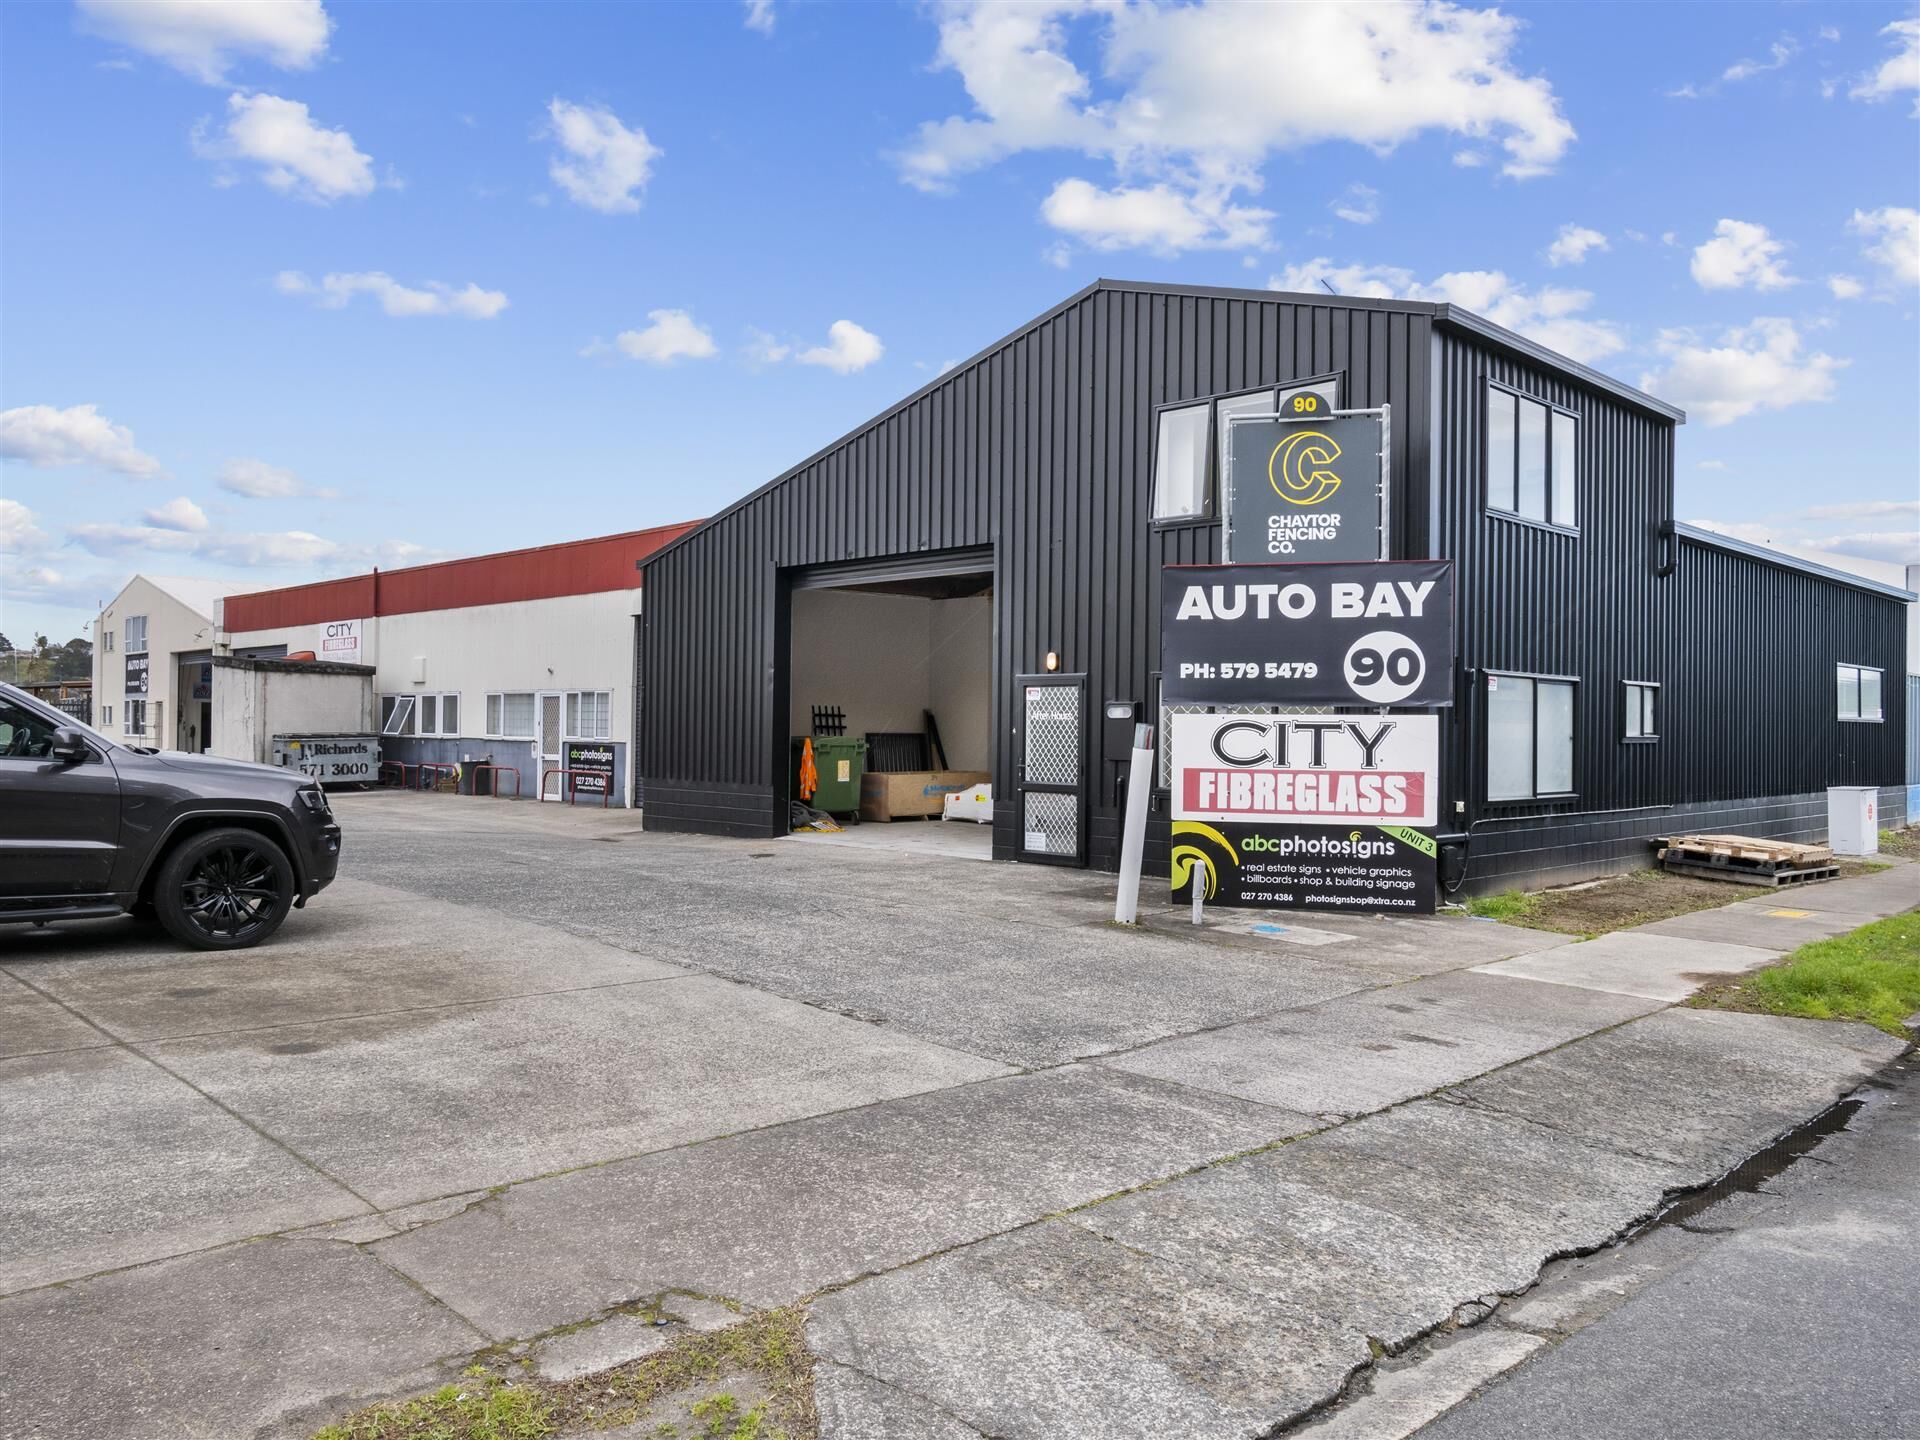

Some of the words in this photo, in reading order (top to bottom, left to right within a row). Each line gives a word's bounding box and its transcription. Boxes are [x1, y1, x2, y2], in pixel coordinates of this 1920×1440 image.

[1293, 397, 1317, 412] 90
[1267, 513, 1341, 528] CHAYTOR
[1268, 527, 1337, 541] FENCING
[1267, 541, 1296, 554] CO.
[1175, 583, 1317, 621] AUTO
[1330, 580, 1436, 619] BAY
[326, 622, 353, 638] CITY
[1179, 663, 1216, 679] PH:
[1220, 662, 1260, 679] 579
[1264, 662, 1319, 679] 5479
[1349, 647, 1422, 687] 90
[1210, 719, 1397, 770] CITY
[300, 763, 325, 777] 571
[331, 762, 369, 776] 3000
[1199, 771, 1407, 814] FIBREGLASS
[1241, 831, 1396, 859] abcphotosigns
[1400, 828, 1426, 847] UNIT
[1425, 842, 1434, 852] 3
[1246, 863, 1265, 872] real
[1266, 864, 1297, 873] estate
[1299, 864, 1322, 875] signs
[1331, 866, 1367, 875] vehicle
[1369, 867, 1412, 877] graphics
[1246, 874, 1293, 884] billboards
[1299, 876, 1323, 886] shop
[1325, 877, 1333, 885] &
[1335, 877, 1374, 888] building
[1375, 878, 1416, 890] signage
[1241, 892, 1256, 900] 027
[1257, 893, 1272, 901] 270
[1273, 893, 1294, 901] 4386
